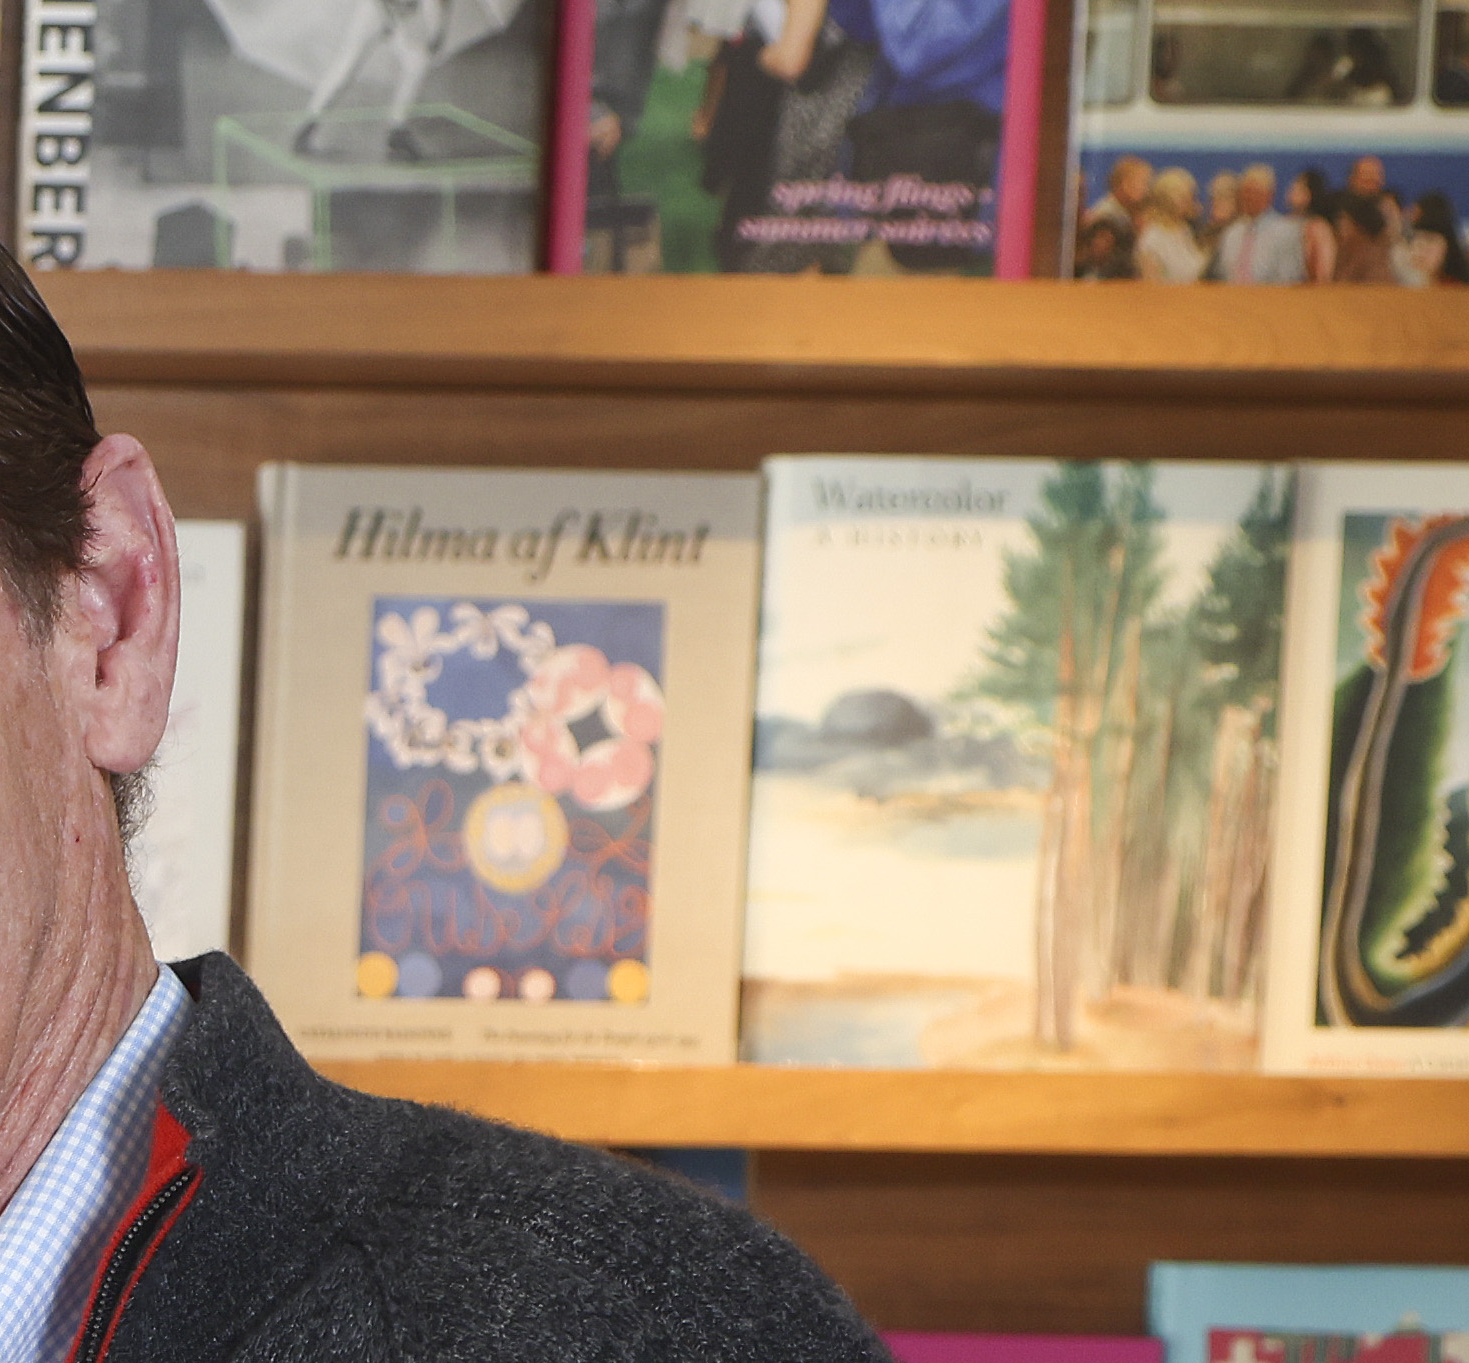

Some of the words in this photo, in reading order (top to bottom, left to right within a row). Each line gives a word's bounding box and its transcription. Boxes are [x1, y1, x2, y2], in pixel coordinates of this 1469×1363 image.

[812, 475, 1010, 513] Watercolor
[332, 506, 494, 562] Hilma
[507, 508, 575, 582] af
[575, 509, 711, 564] Klint
